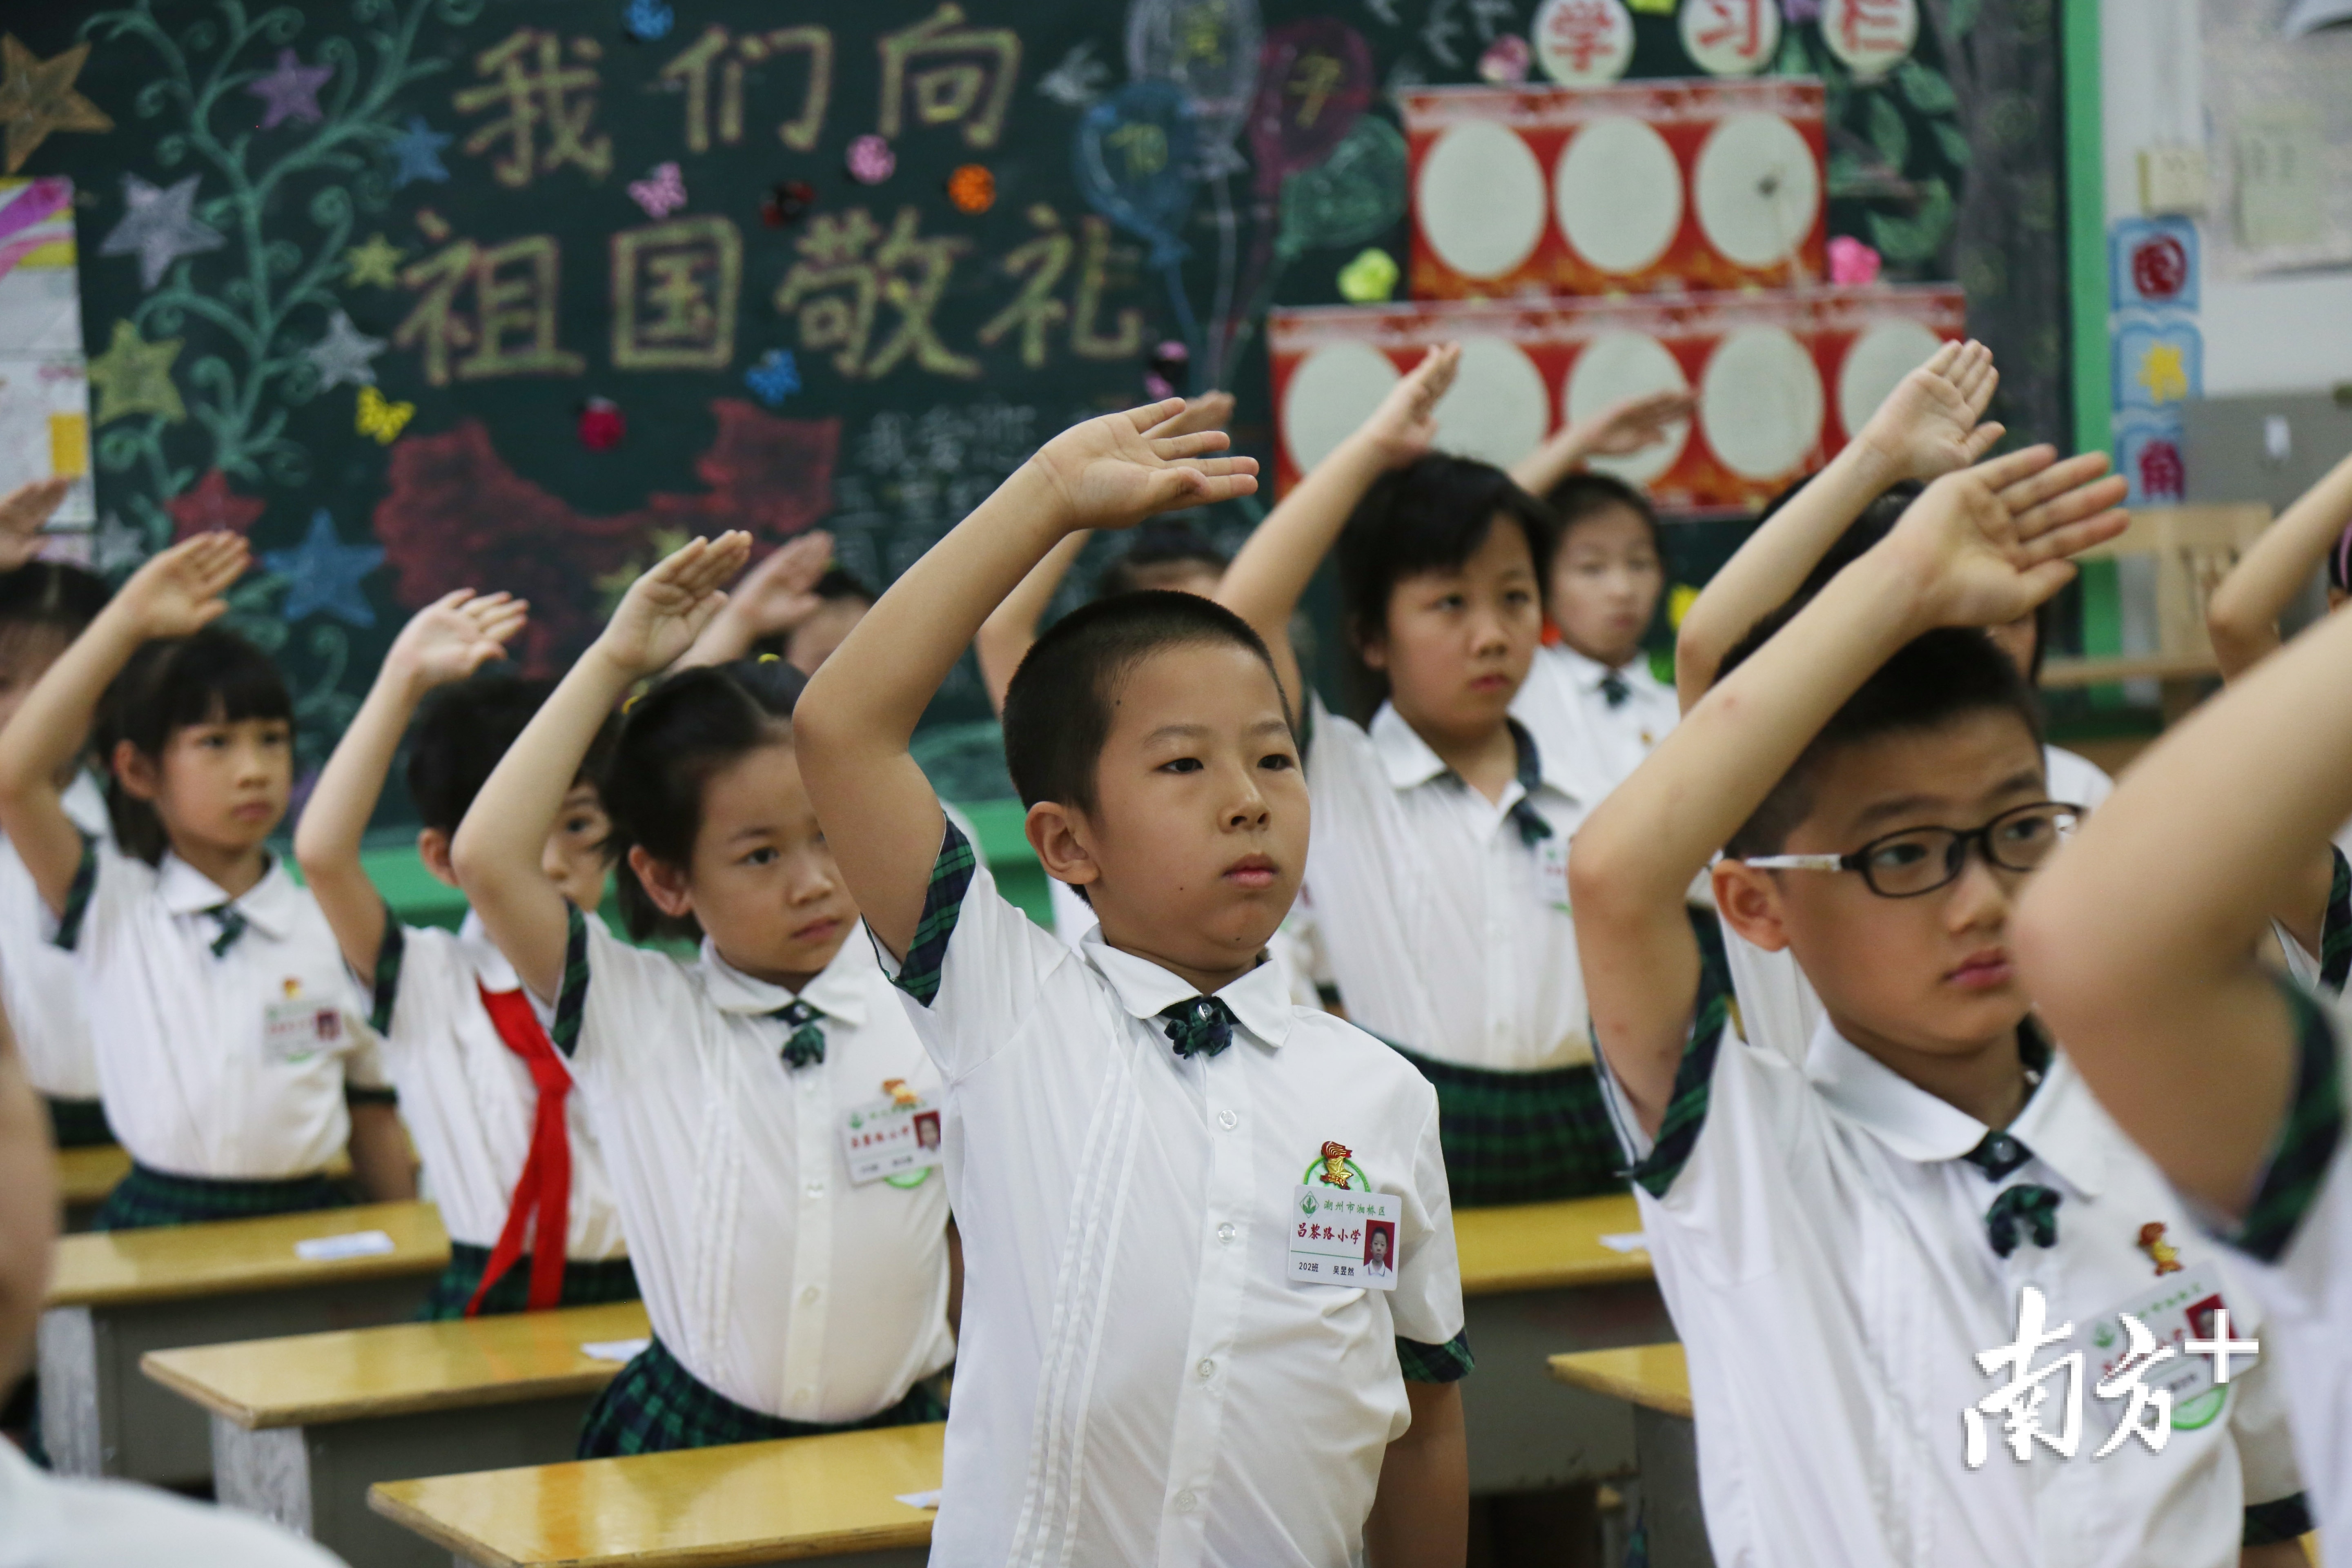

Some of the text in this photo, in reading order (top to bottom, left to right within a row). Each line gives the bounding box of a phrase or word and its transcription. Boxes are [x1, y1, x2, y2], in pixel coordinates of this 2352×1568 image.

[453, 2, 1021, 186] 我们向
[395, 203, 1140, 385] 祖国敬礼
[1324, 1200, 1385, 1216] 潮州市湘桥区
[1298, 1222, 1361, 1245] 昌黎路小学
[1299, 1262, 1319, 1272] 202班
